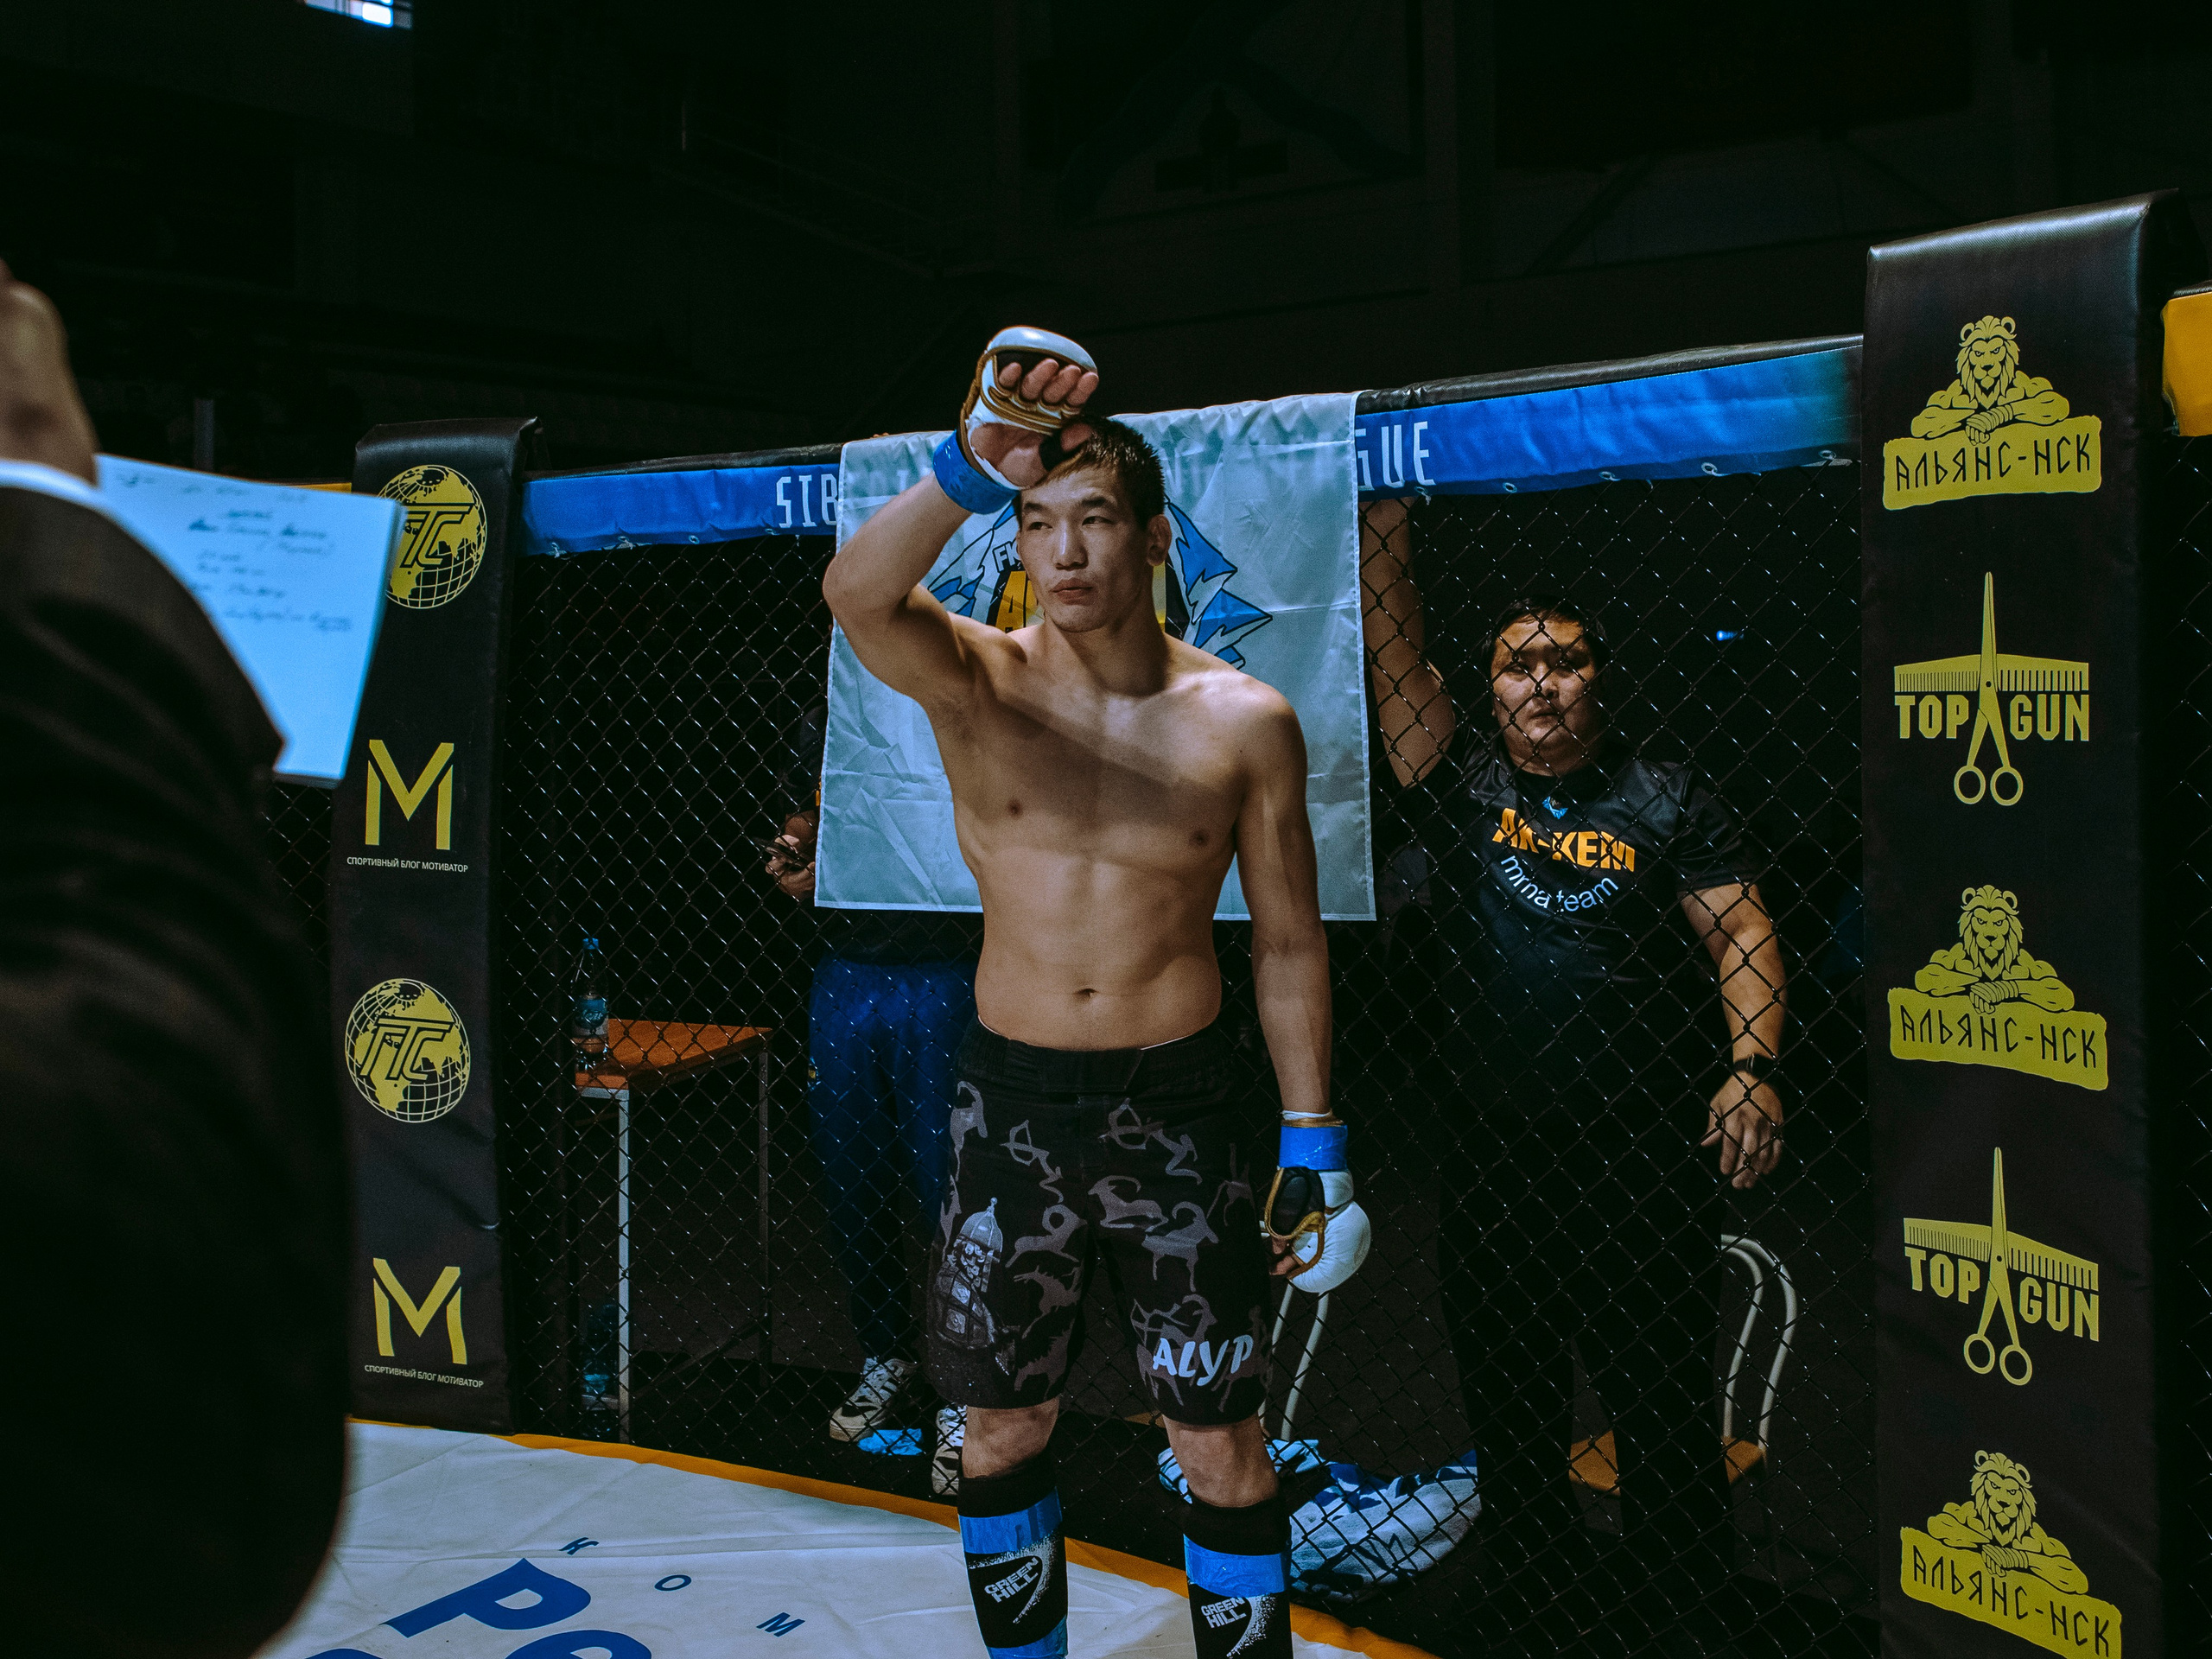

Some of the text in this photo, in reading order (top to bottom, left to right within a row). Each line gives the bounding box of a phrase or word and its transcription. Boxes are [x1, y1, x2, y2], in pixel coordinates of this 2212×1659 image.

[1356, 421, 1436, 491] GUE
[1895, 433, 2090, 492] АЛЬЯНС-НСК
[775, 472, 839, 529] SIB
[1894, 694, 2089, 741] TOP GUN
[346, 856, 468, 873] СПОРТИВНЫЙ БЛОГ МОТИВАТОР
[1501, 855, 1619, 912] mma team
[1900, 1005, 2097, 1068] АЛЬЯНС-НСК
[1904, 1245, 2100, 1342] TOP GUN
[364, 1364, 484, 1388] СПОРТИВНЫЙ БЛОГ МОТИВАТОР
[1152, 1334, 1254, 1387] ALYP
[983, 1556, 1040, 1595] GREEN
[991, 1572, 1039, 1604] HILL
[1912, 1544, 2110, 1657] АЛЬЯНС-НСК
[1200, 1597, 1246, 1617] GREEN
[1205, 1609, 1247, 1629] HILL
